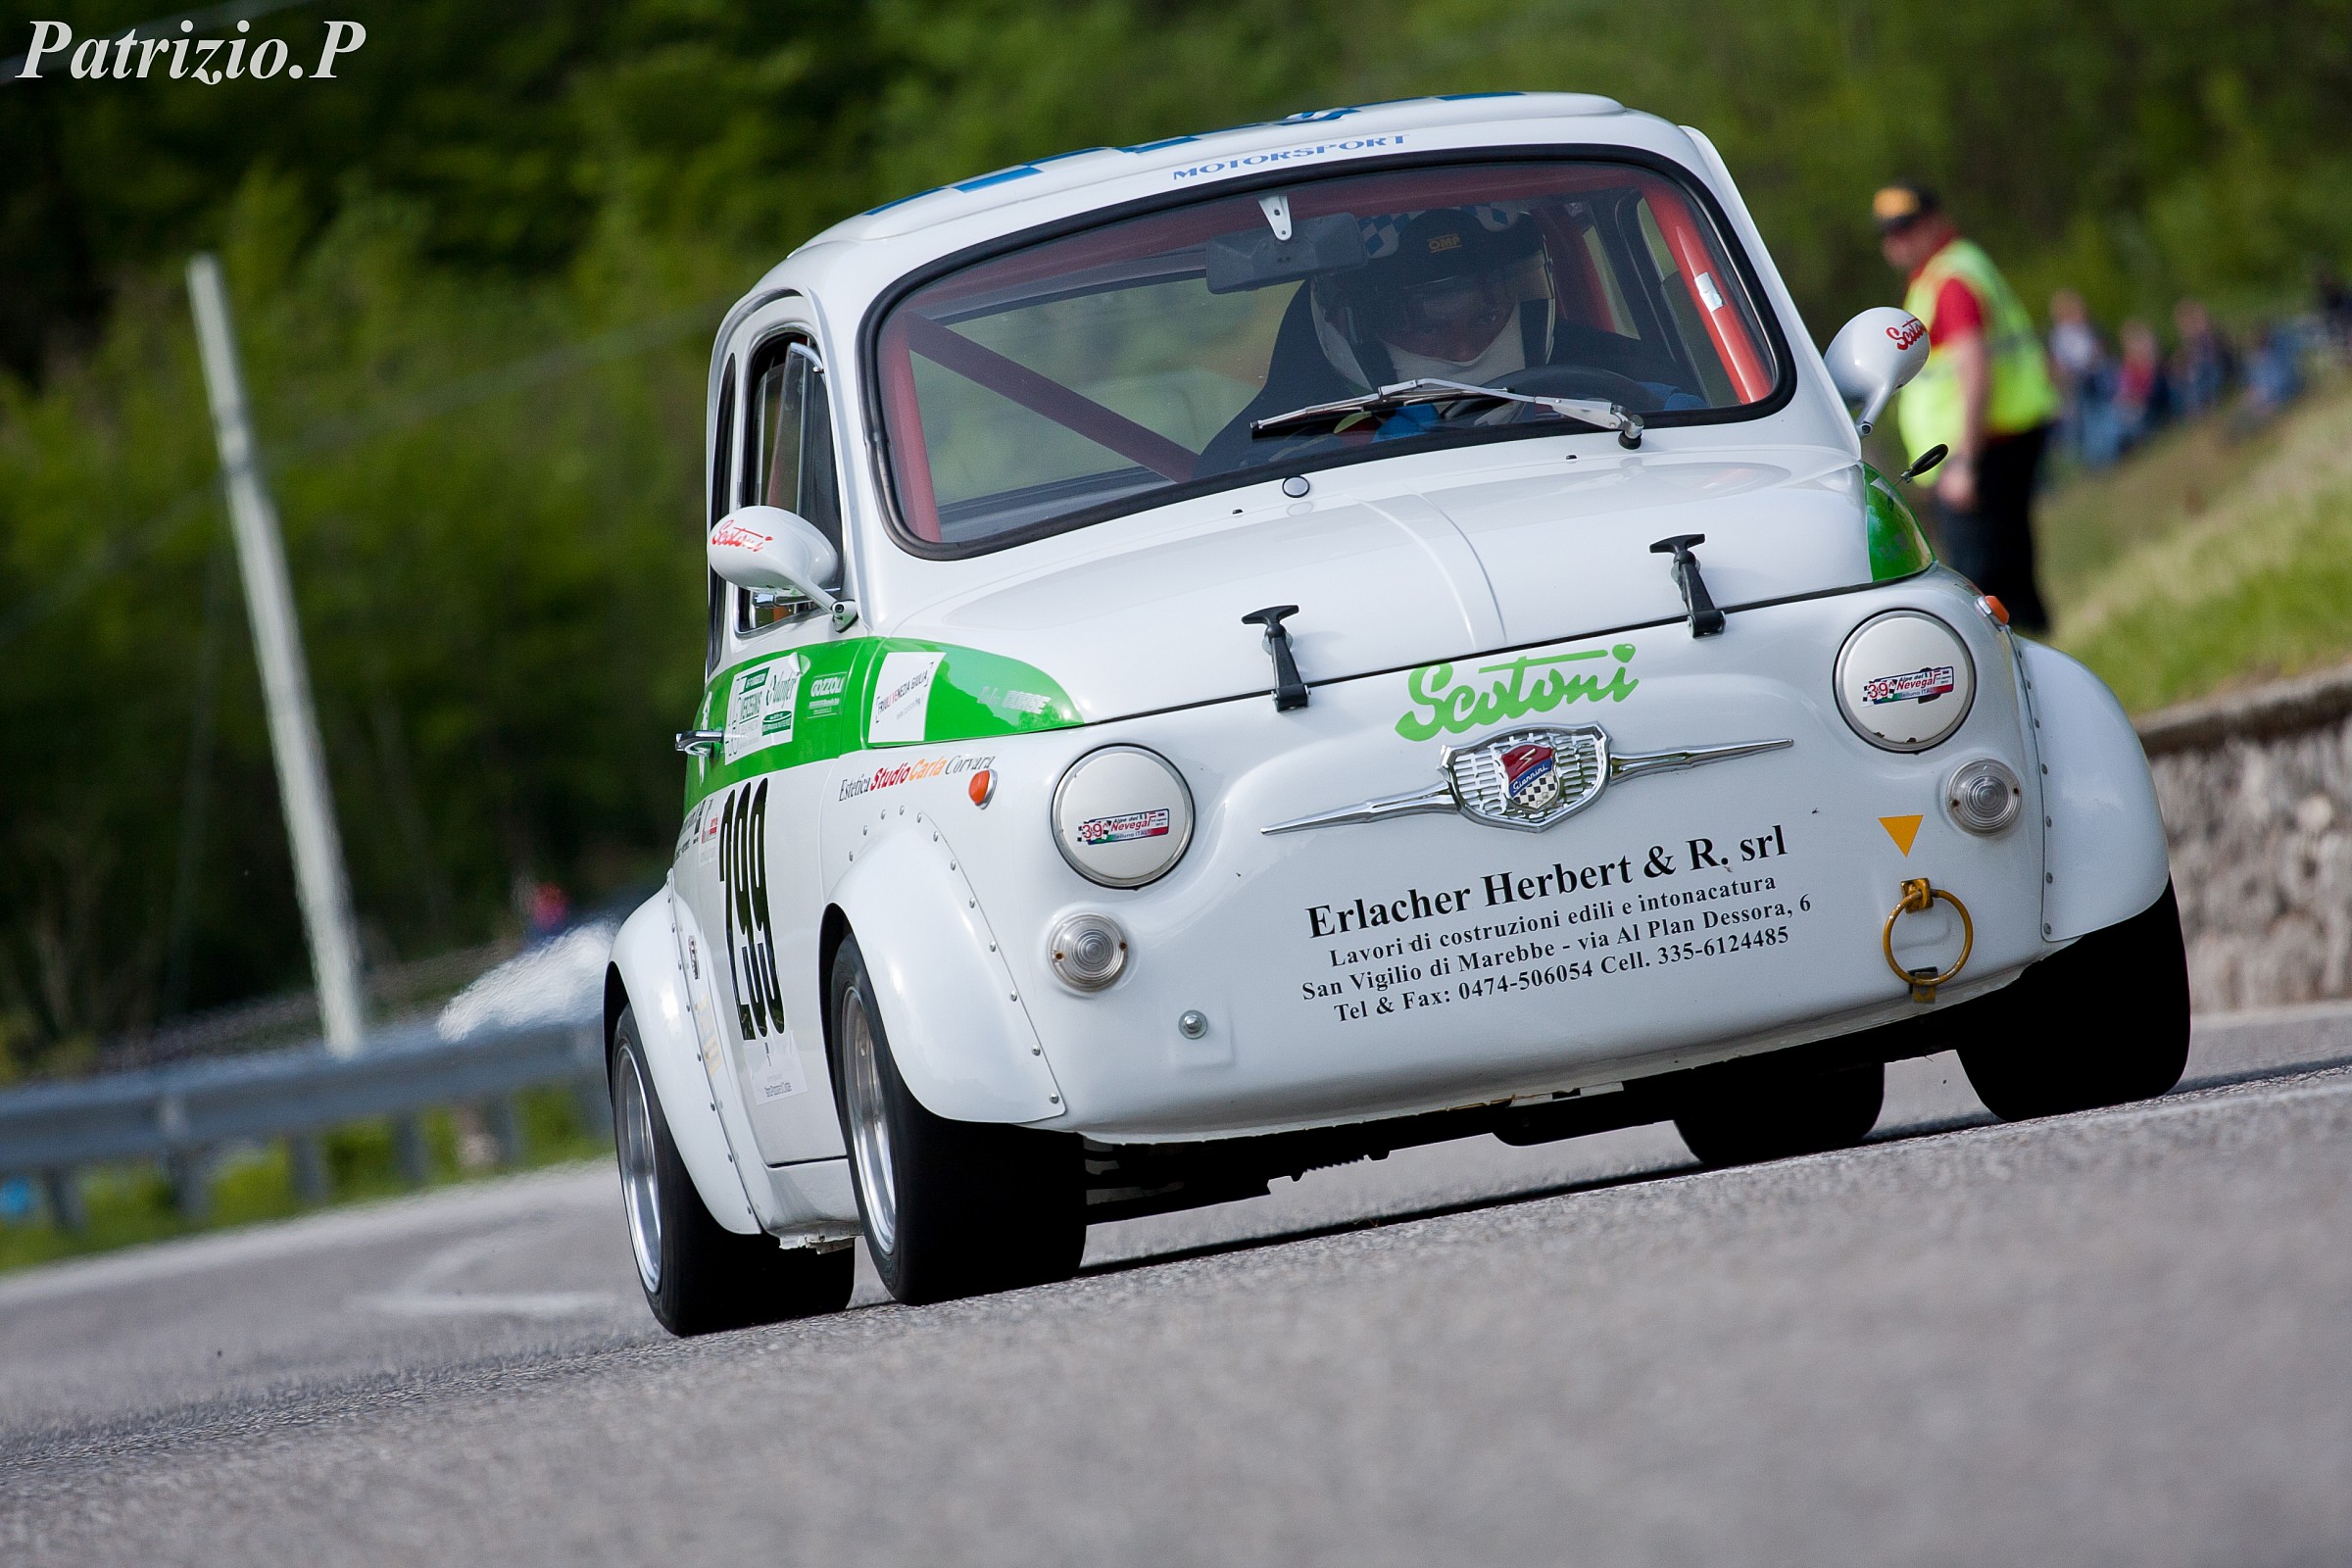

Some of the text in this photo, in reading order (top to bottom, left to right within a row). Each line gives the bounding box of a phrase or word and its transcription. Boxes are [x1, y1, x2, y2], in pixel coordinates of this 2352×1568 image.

[1173, 134, 1409, 180] MOTORSPORT
[1428, 234, 1460, 250] OMP
[1395, 643, 1640, 742] Scotoni
[1897, 672, 1936, 691] Nevegal
[839, 755, 996, 802] Estetica Studio Carla Corvara
[1110, 815, 1152, 832] Nevegal
[719, 777, 785, 1041] 299
[1304, 824, 1788, 939] Erlacher Herbert & R. srl
[1329, 876, 1777, 967] Lavori di costruzioni edili e intonacatura
[1301, 980, 1344, 1002] San
[1348, 964, 1422, 992] Vigilio
[1430, 956, 1451, 978] di
[1456, 941, 1556, 972] Marebbe
[1577, 931, 1610, 952] via
[1616, 923, 1642, 945] Al
[1646, 917, 1695, 939] Plan
[1702, 902, 1793, 930] Dessora,
[1799, 893, 1812, 911] 6
[1334, 925, 1789, 1022] Tel & Fax: 0474-506054 Cell. 335-6124485
